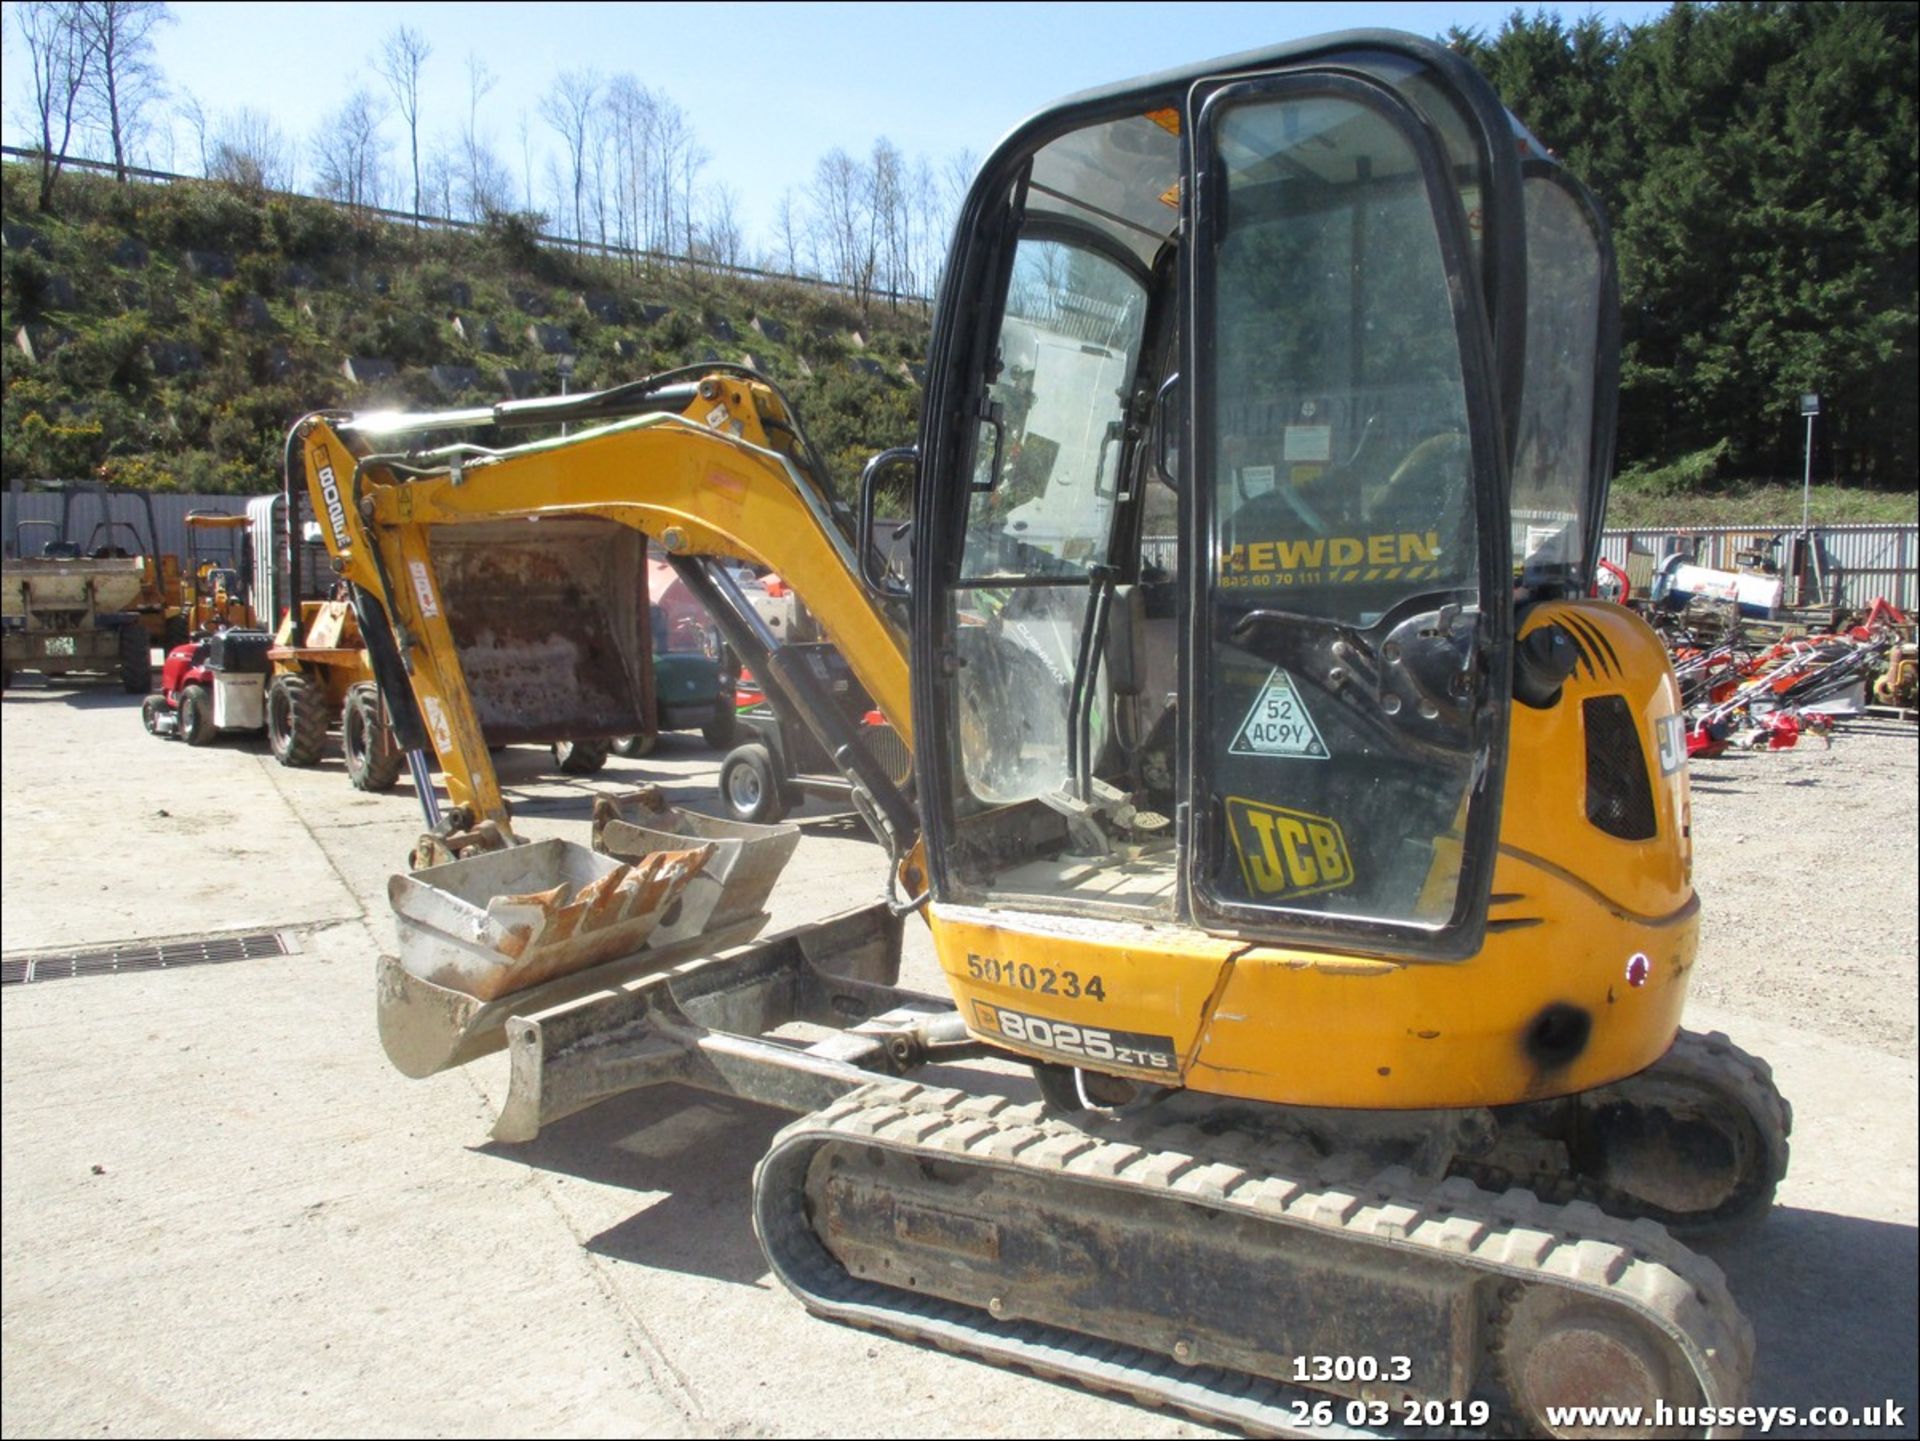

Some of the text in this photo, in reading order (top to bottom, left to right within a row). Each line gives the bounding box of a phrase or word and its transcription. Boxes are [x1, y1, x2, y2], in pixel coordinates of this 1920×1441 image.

[1275, 573, 1294, 586] 70
[1267, 700, 1292, 720] 52
[1253, 723, 1304, 744] AC9Y
[1247, 810, 1345, 894] JCB
[967, 953, 1106, 1002] 5010234
